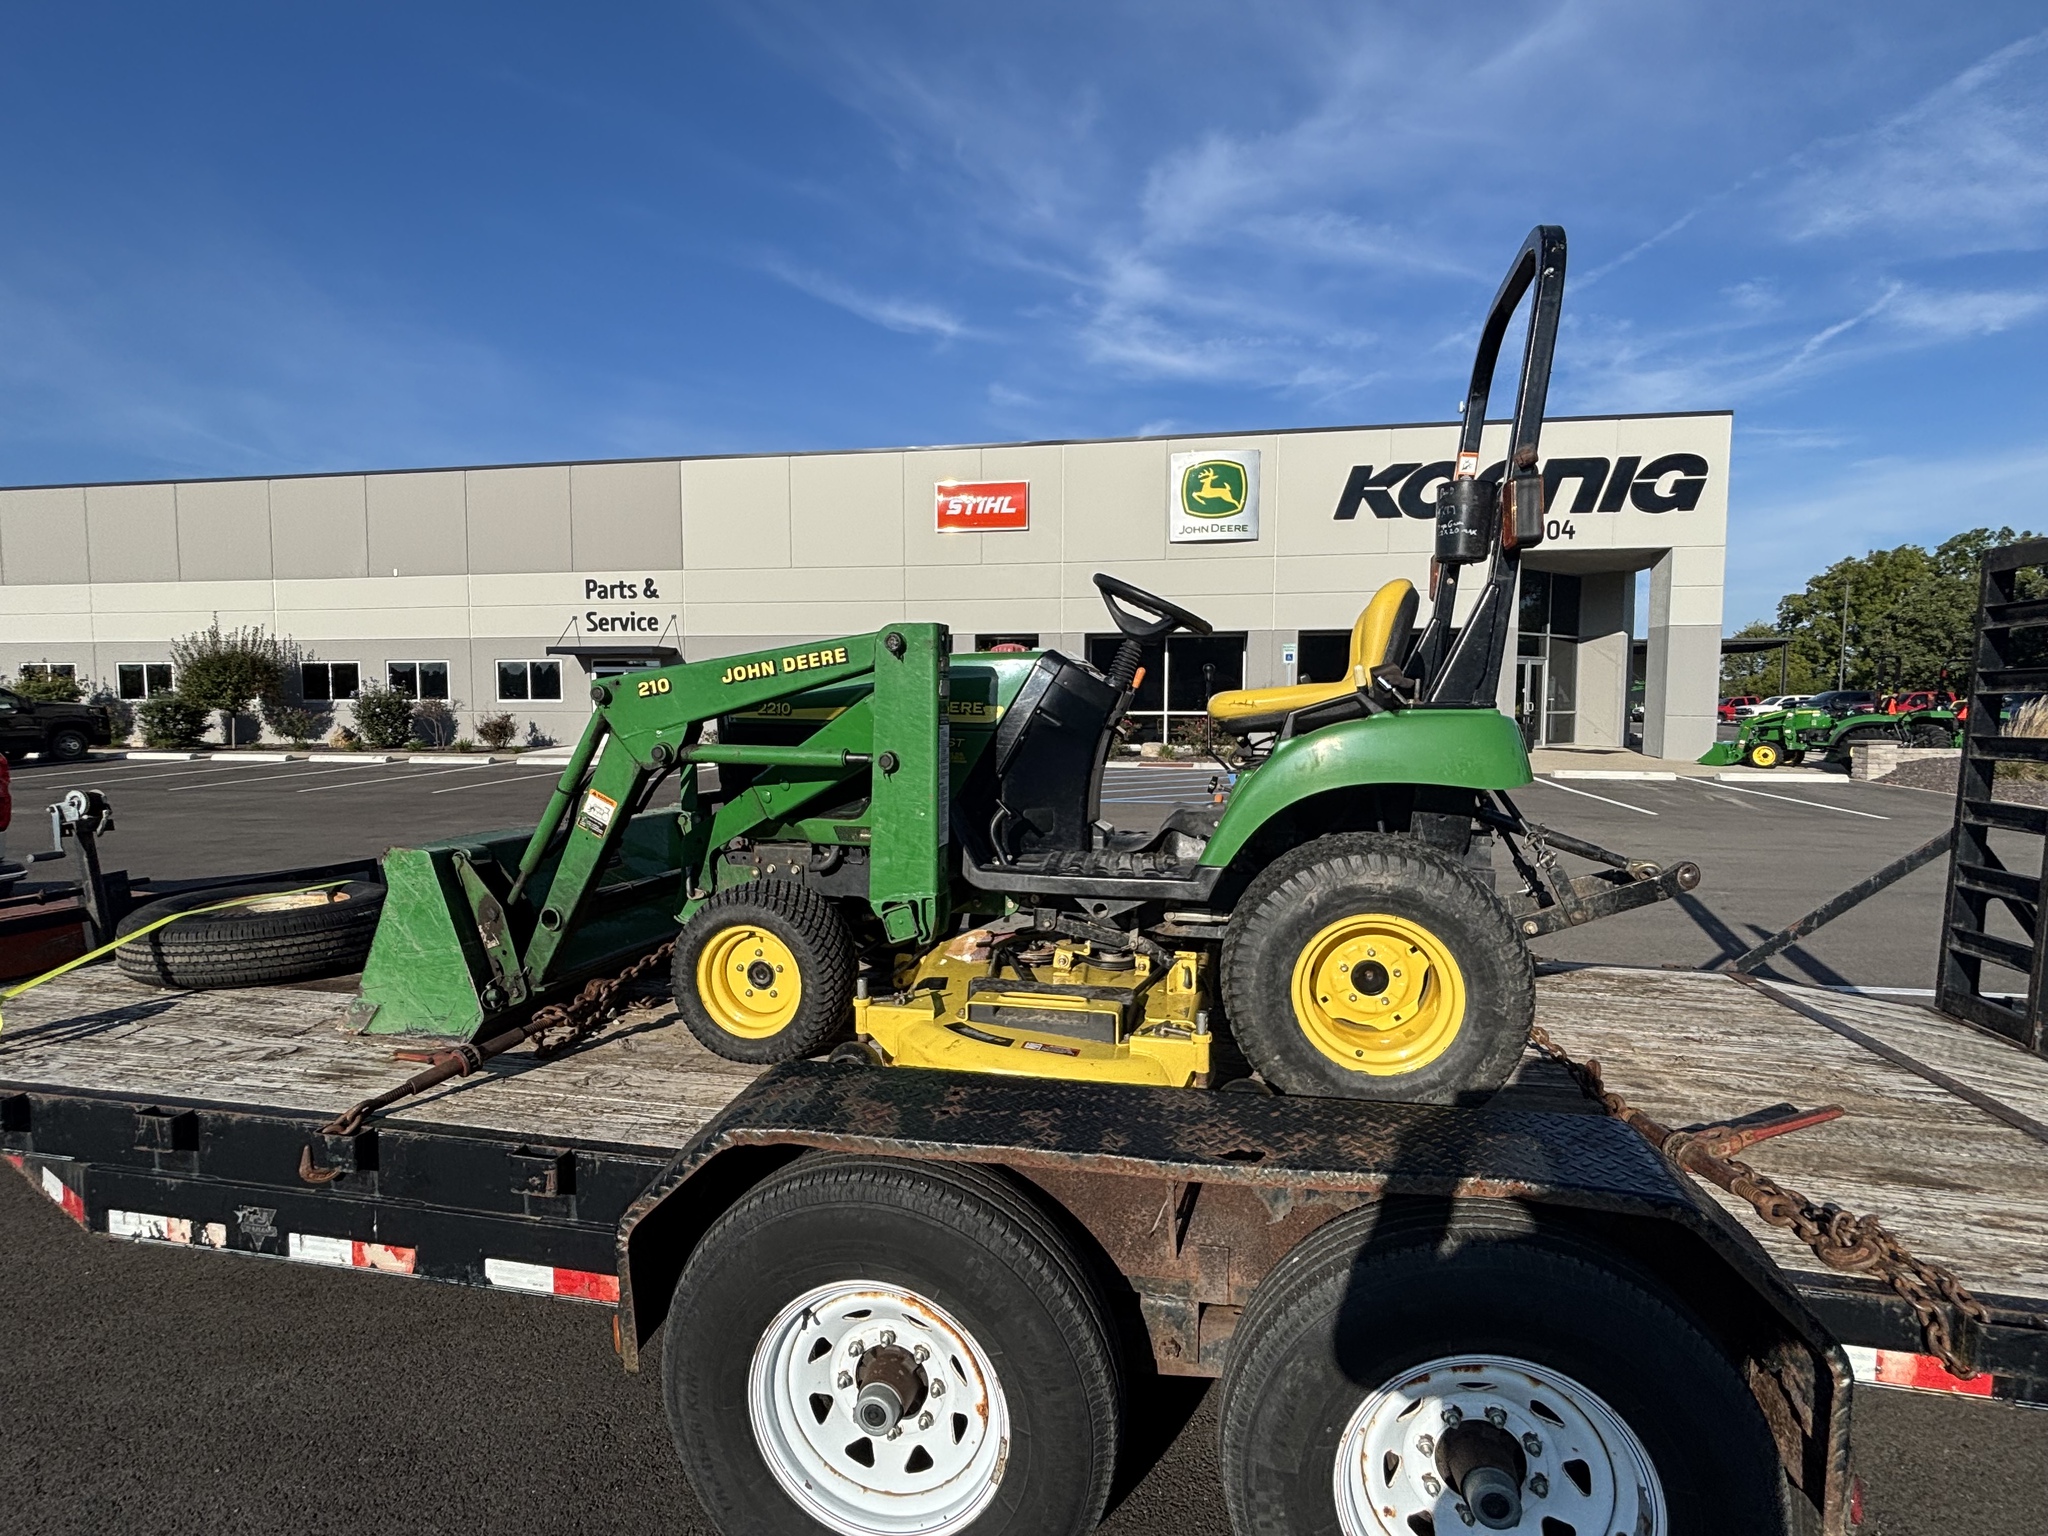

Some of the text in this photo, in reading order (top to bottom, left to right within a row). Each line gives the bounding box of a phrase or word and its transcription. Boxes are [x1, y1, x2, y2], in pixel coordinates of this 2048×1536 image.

[1333, 453, 1709, 520] KONIG
[946, 496, 1016, 515] STIHL
[1178, 523, 1249, 535] JOHN DEERE
[585, 578, 660, 599] Parts &
[586, 611, 659, 632] Service
[638, 647, 848, 697] 210 JOHN DEERE
[949, 701, 984, 714] ERE
